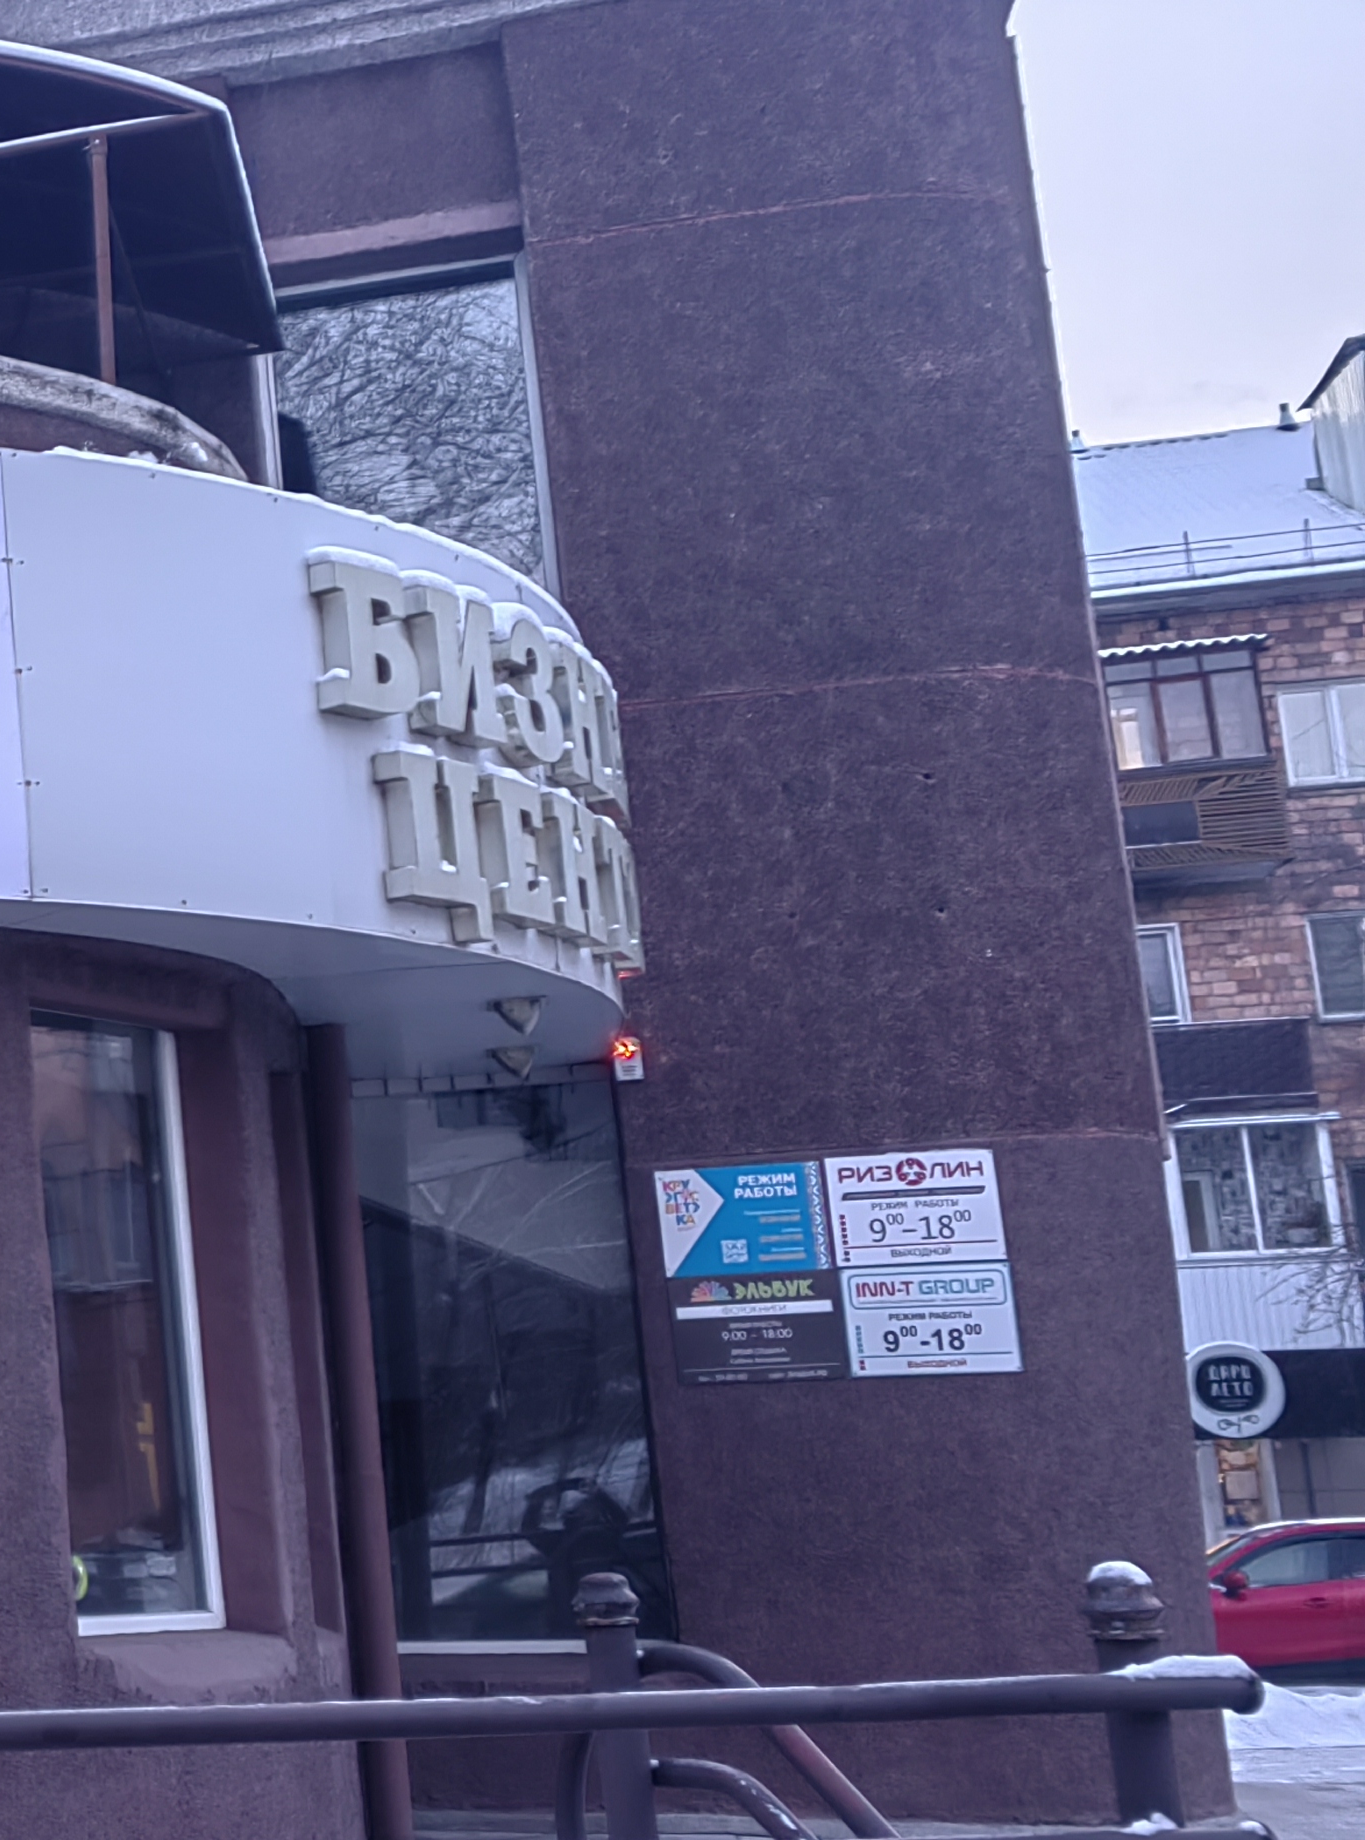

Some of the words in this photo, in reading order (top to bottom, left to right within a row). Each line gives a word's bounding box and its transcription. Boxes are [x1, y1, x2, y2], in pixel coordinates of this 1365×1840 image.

[738, 1173, 795, 1186] РЕЖИМ
[734, 1185, 797, 1199] РАБОТЫ
[871, 1201, 908, 1211] РЕЖИМ
[914, 1199, 959, 1208] РАБОТЫ
[891, 1246, 952, 1257] ВЫХОДНОЙ
[855, 1281, 914, 1298] INN-T
[918, 1278, 994, 1295] GROUP
[888, 1312, 926, 1321] РЕЖИМ
[928, 1311, 972, 1320] РАБОТЫ
